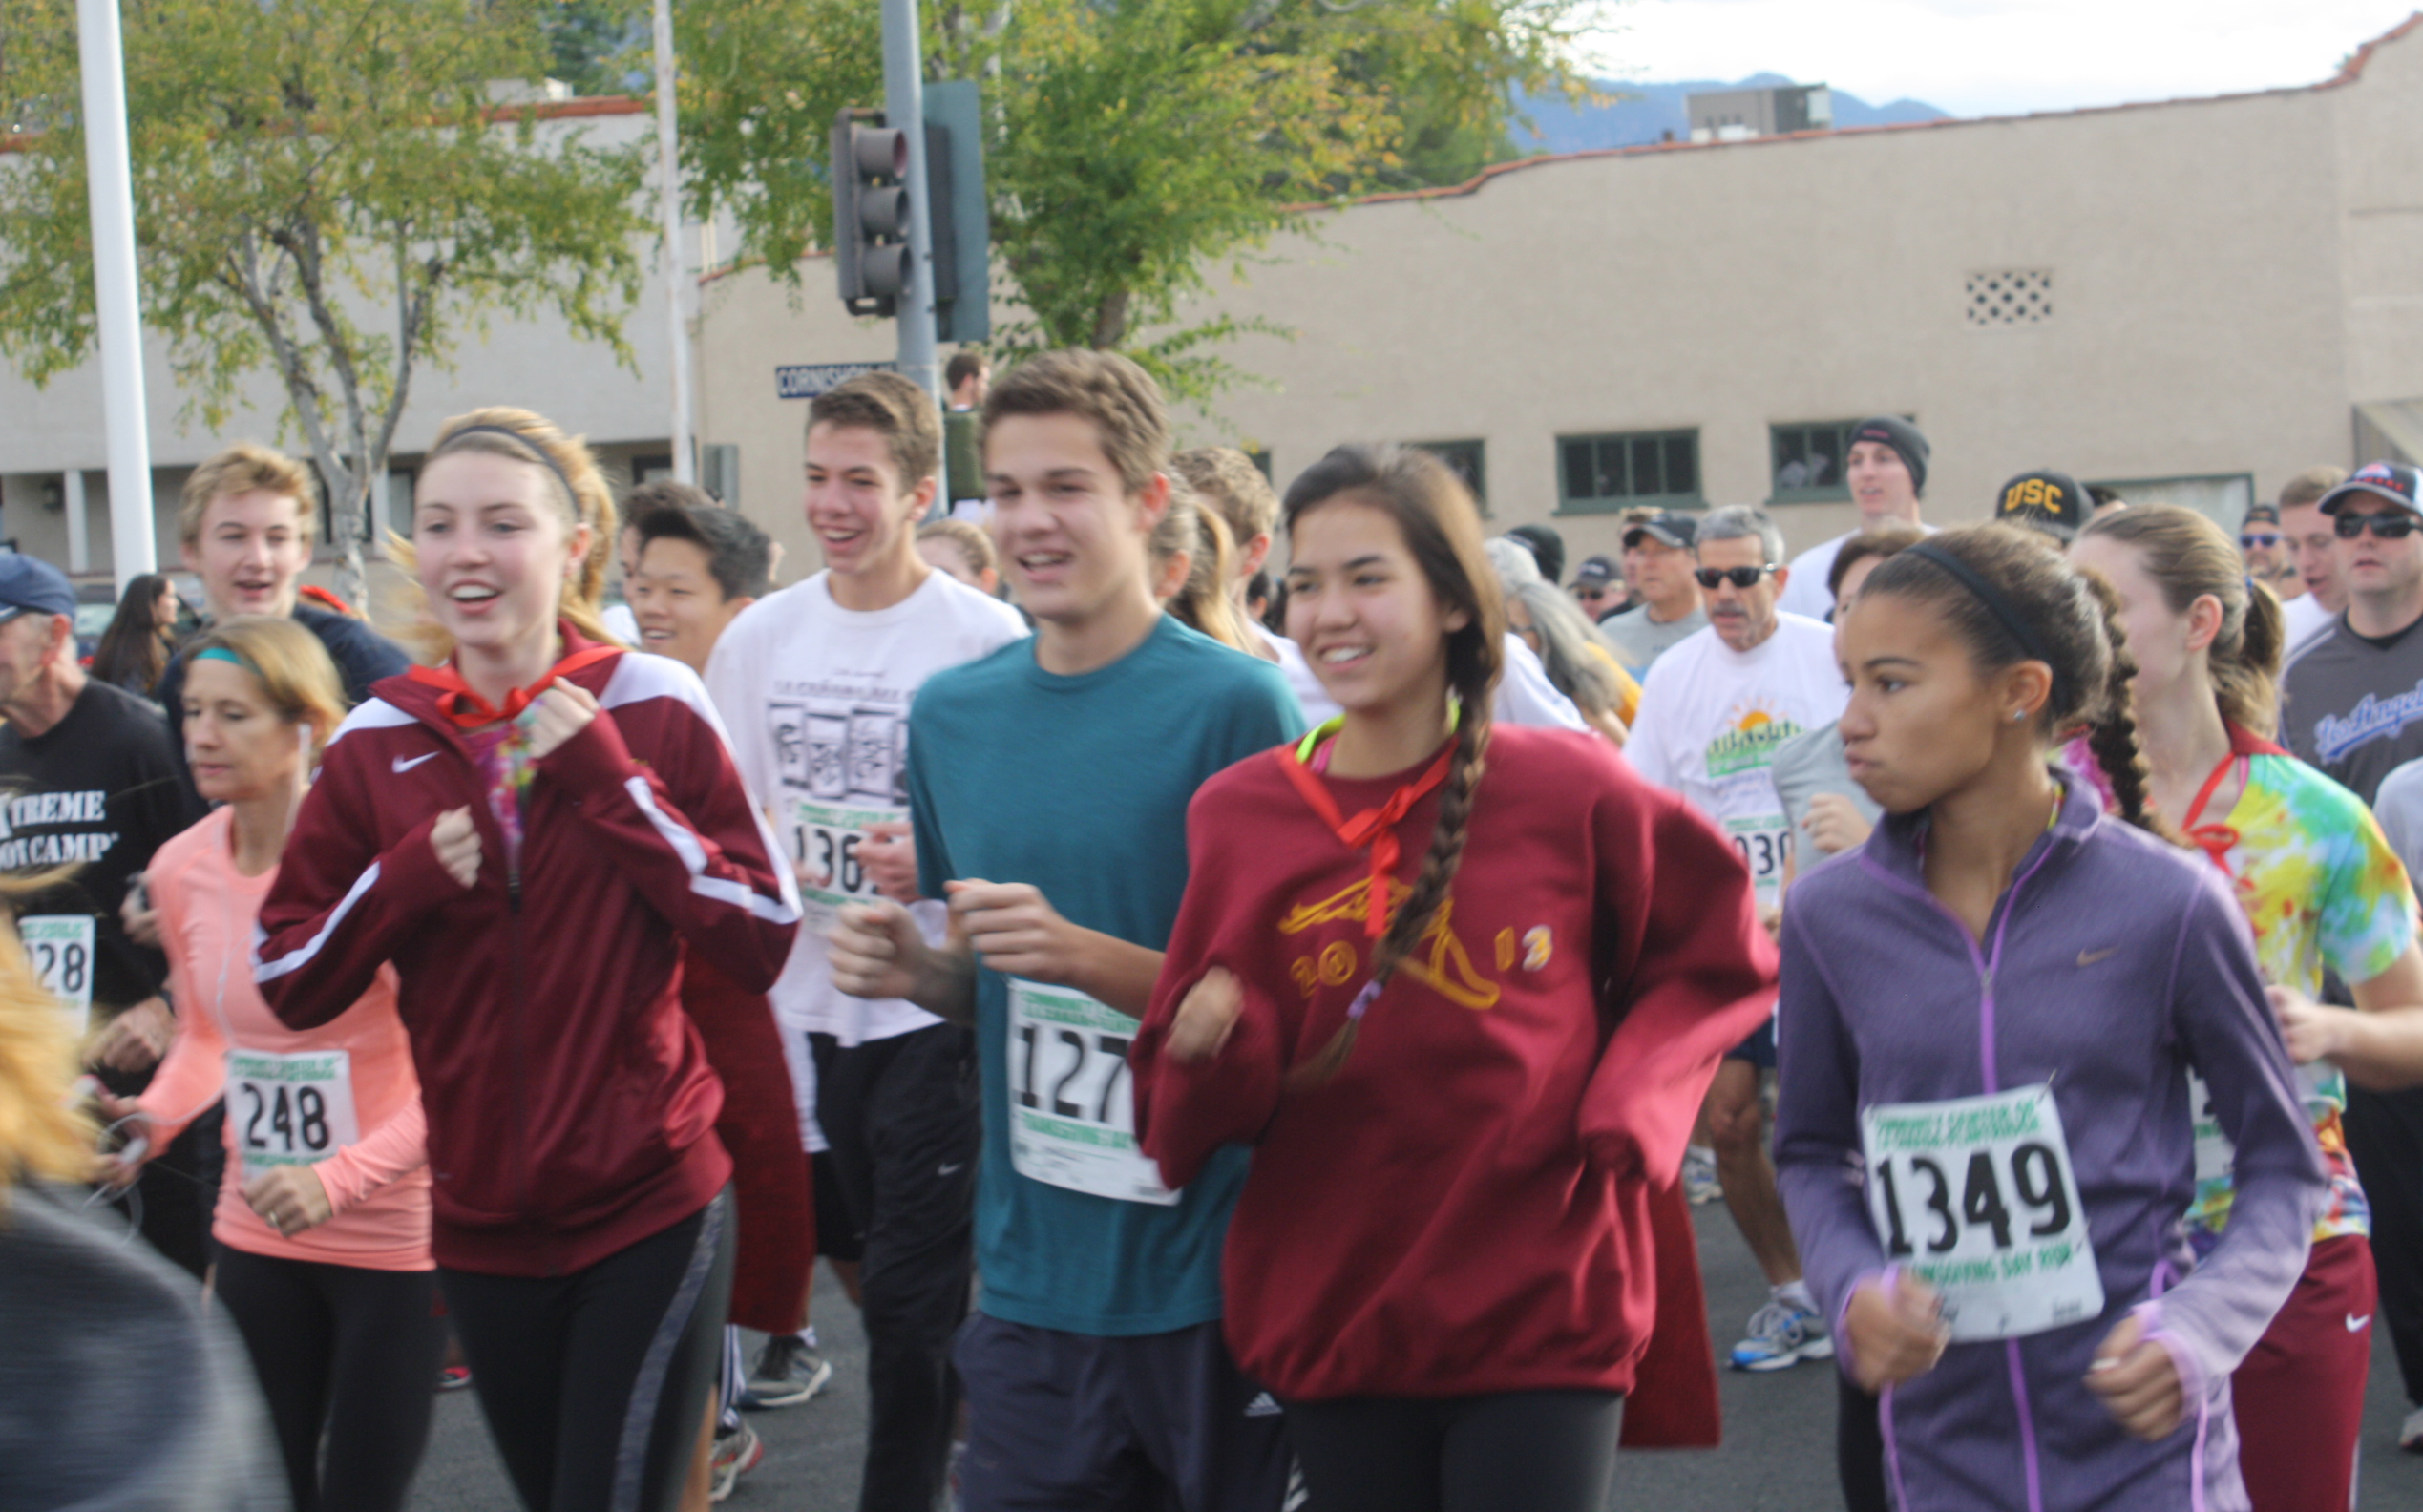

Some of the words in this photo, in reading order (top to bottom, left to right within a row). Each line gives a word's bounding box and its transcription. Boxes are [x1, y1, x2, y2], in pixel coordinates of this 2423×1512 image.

[2004, 478, 2063, 514] USC
[2314, 713, 2356, 760] Los
[1494, 924, 1553, 972] 13
[1016, 1025, 1130, 1123] 127
[241, 1082, 330, 1151] 248
[1876, 1142, 2072, 1258] 1349
